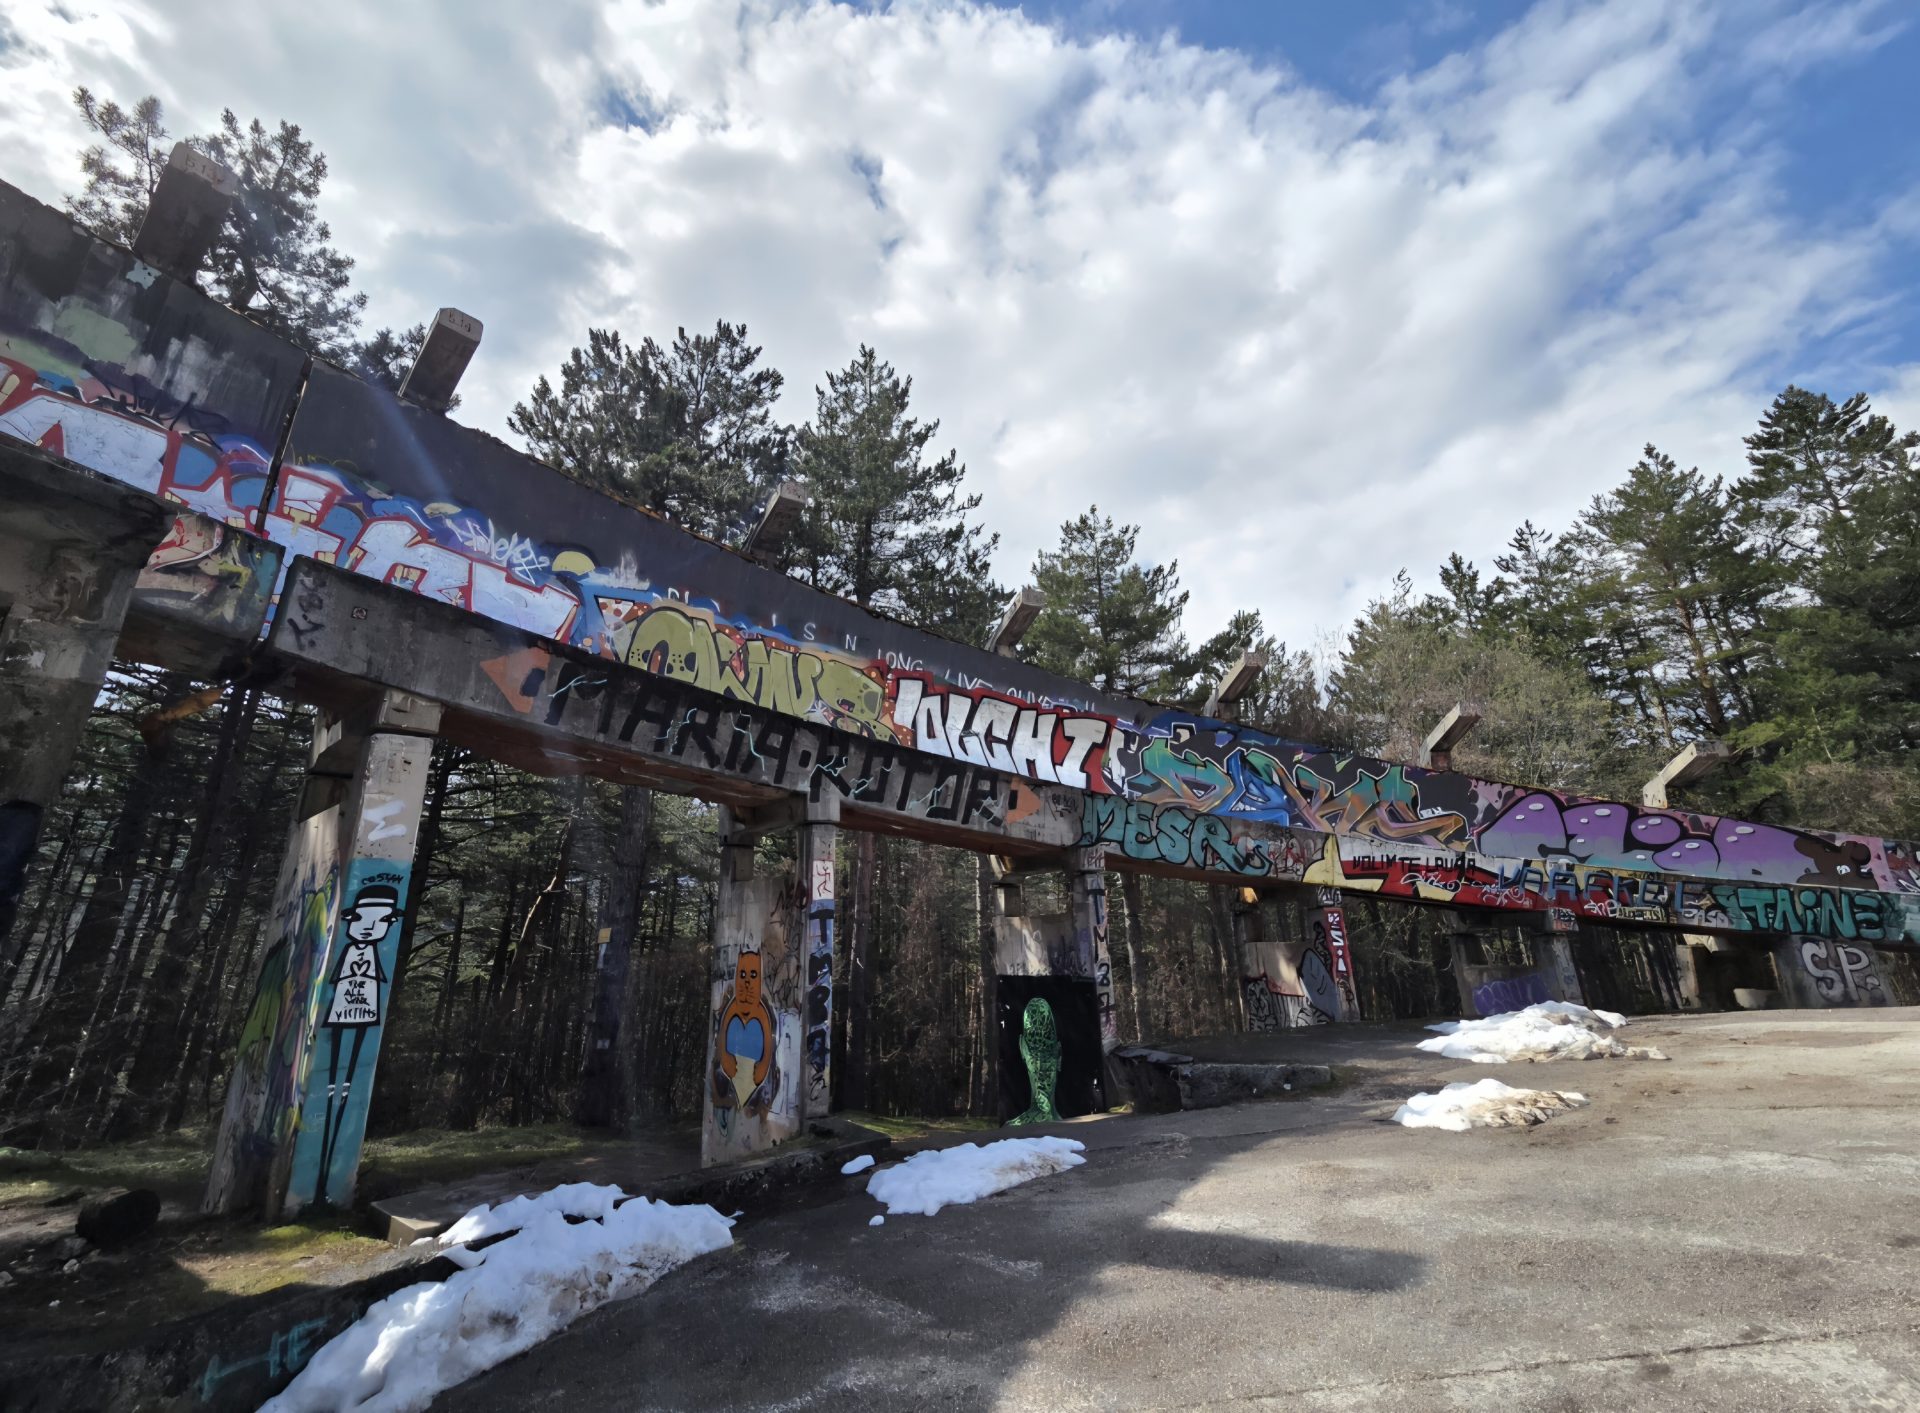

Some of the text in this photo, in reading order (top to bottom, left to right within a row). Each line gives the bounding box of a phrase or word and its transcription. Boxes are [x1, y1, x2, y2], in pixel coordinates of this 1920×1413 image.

[877, 648, 923, 671] LONG
[344, 988, 365, 998] ALL
[335, 1007, 377, 1021] VICTIMS
